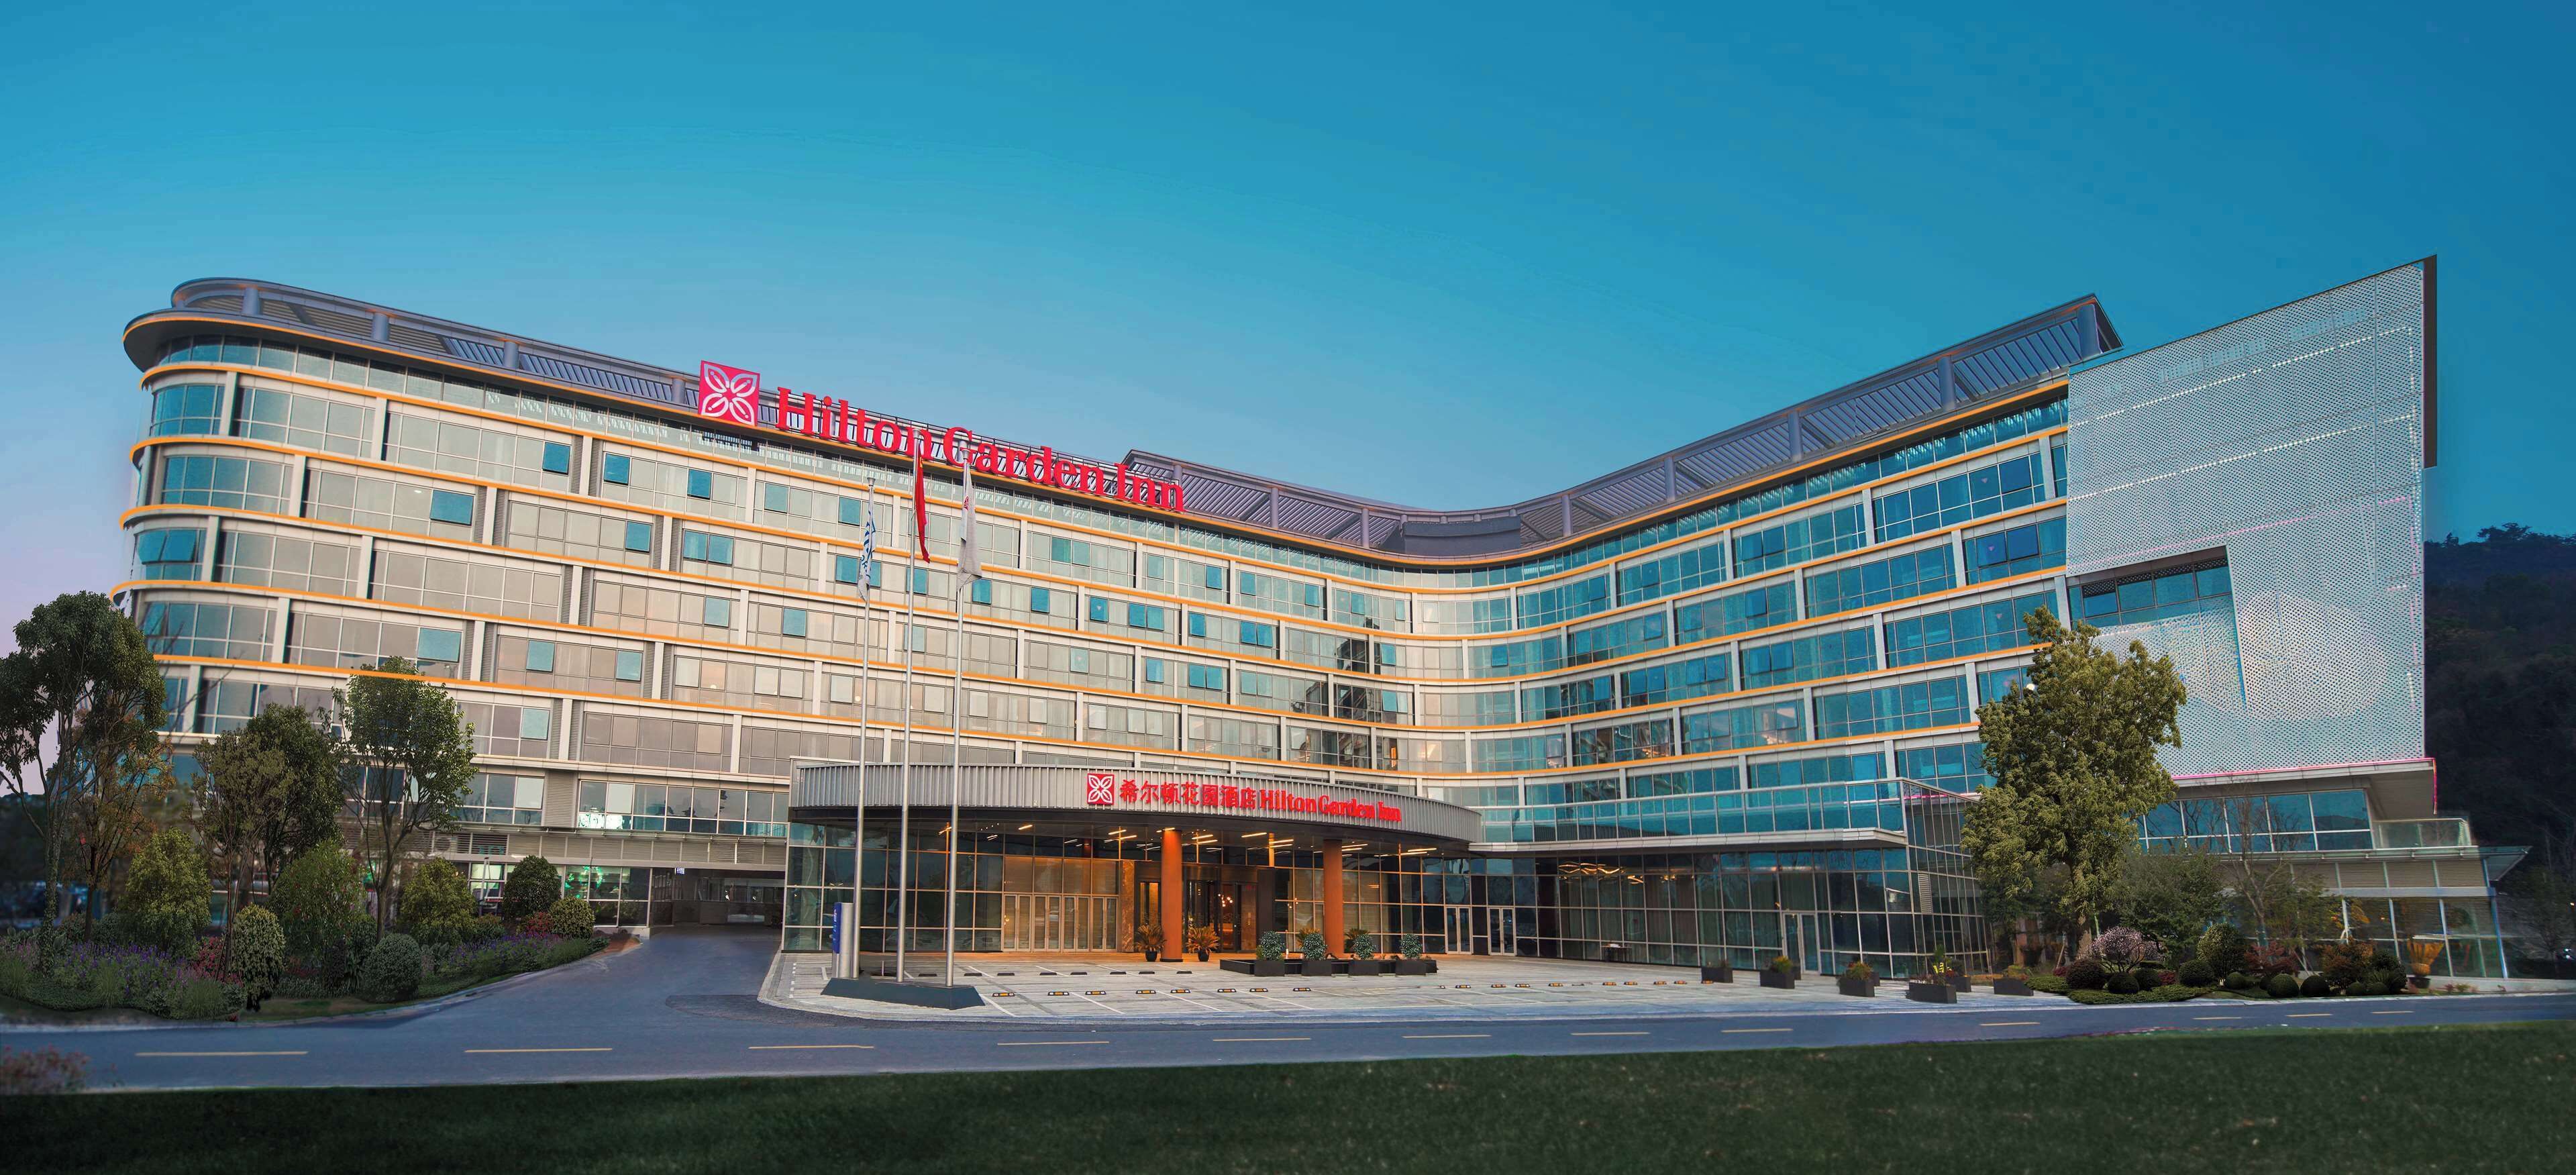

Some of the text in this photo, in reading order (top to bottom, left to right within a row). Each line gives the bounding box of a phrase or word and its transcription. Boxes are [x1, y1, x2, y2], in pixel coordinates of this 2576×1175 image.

[775, 387, 1188, 513] Hilton Garden Inn
[1119, 778, 1402, 823] 希尔顿花园酒店 Hilton Garden Inn
